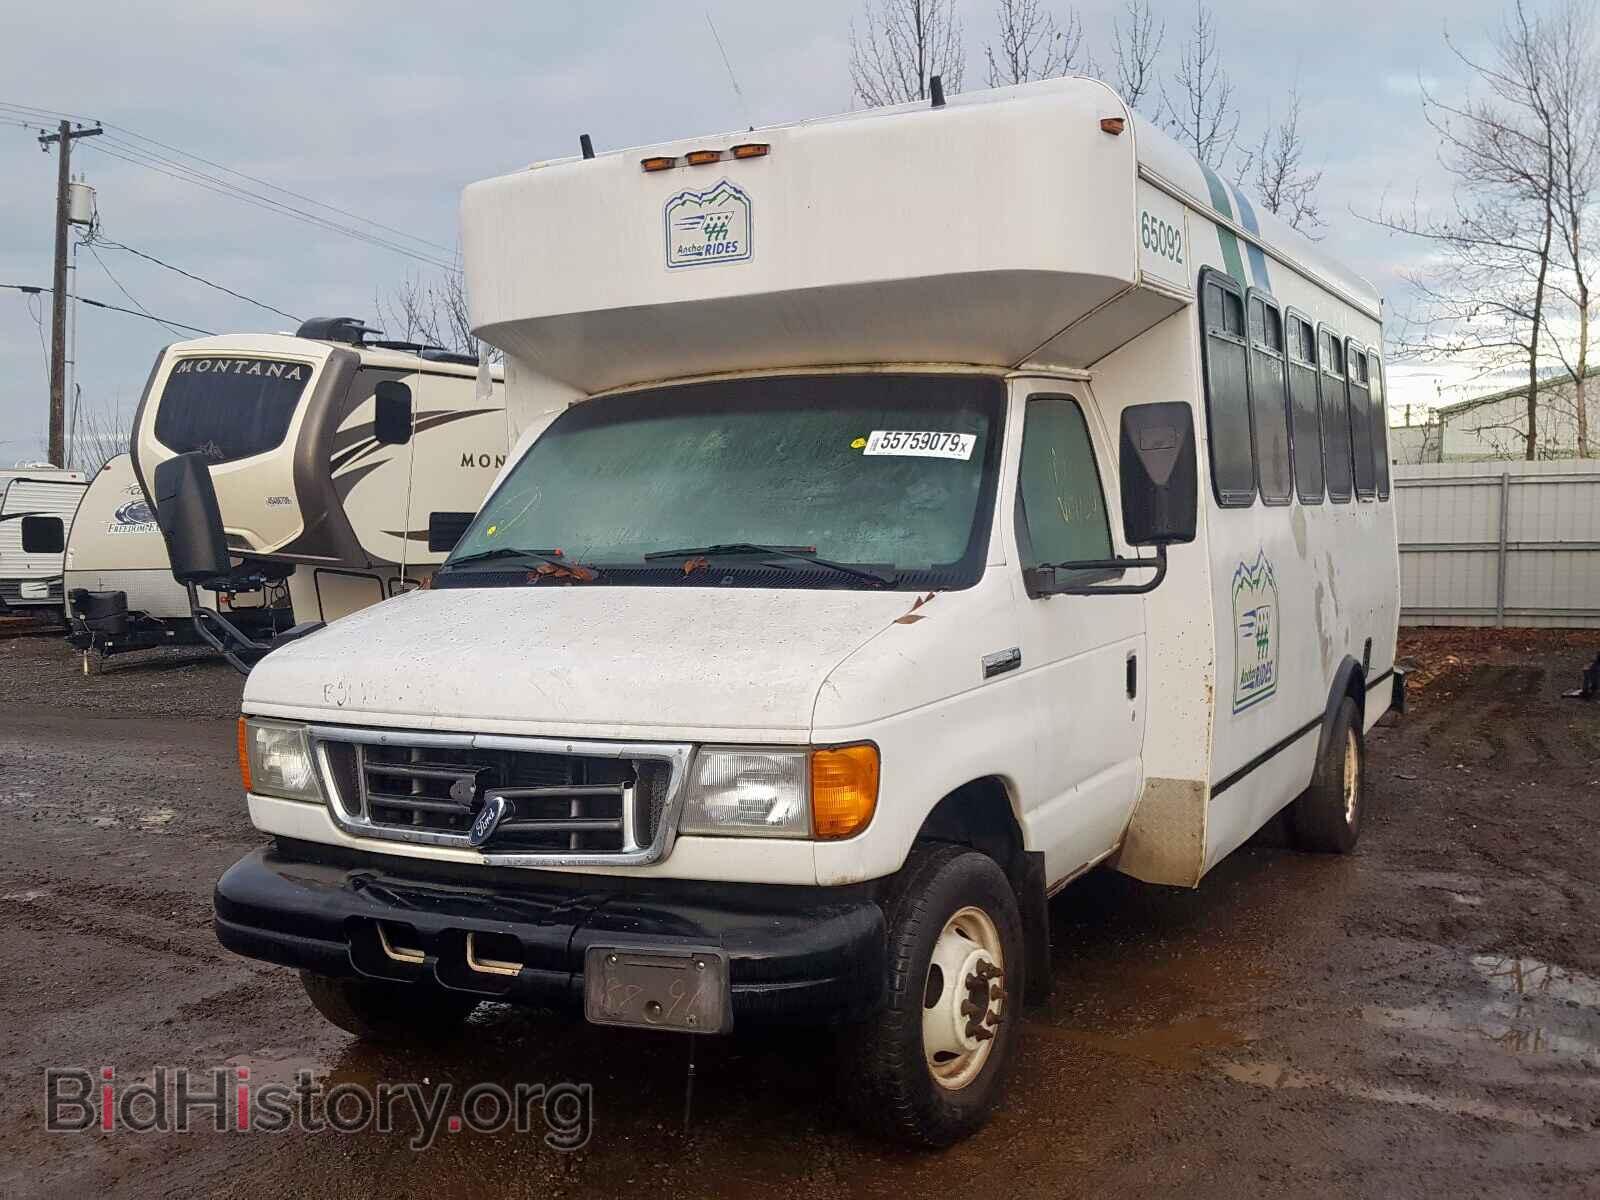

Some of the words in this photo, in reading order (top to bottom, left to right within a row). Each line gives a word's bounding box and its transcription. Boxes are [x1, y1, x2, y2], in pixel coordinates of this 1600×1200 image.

[1141, 211, 1183, 264] 65092
[176, 359, 302, 380] MONTANA
[476, 807, 495, 837] Ford
